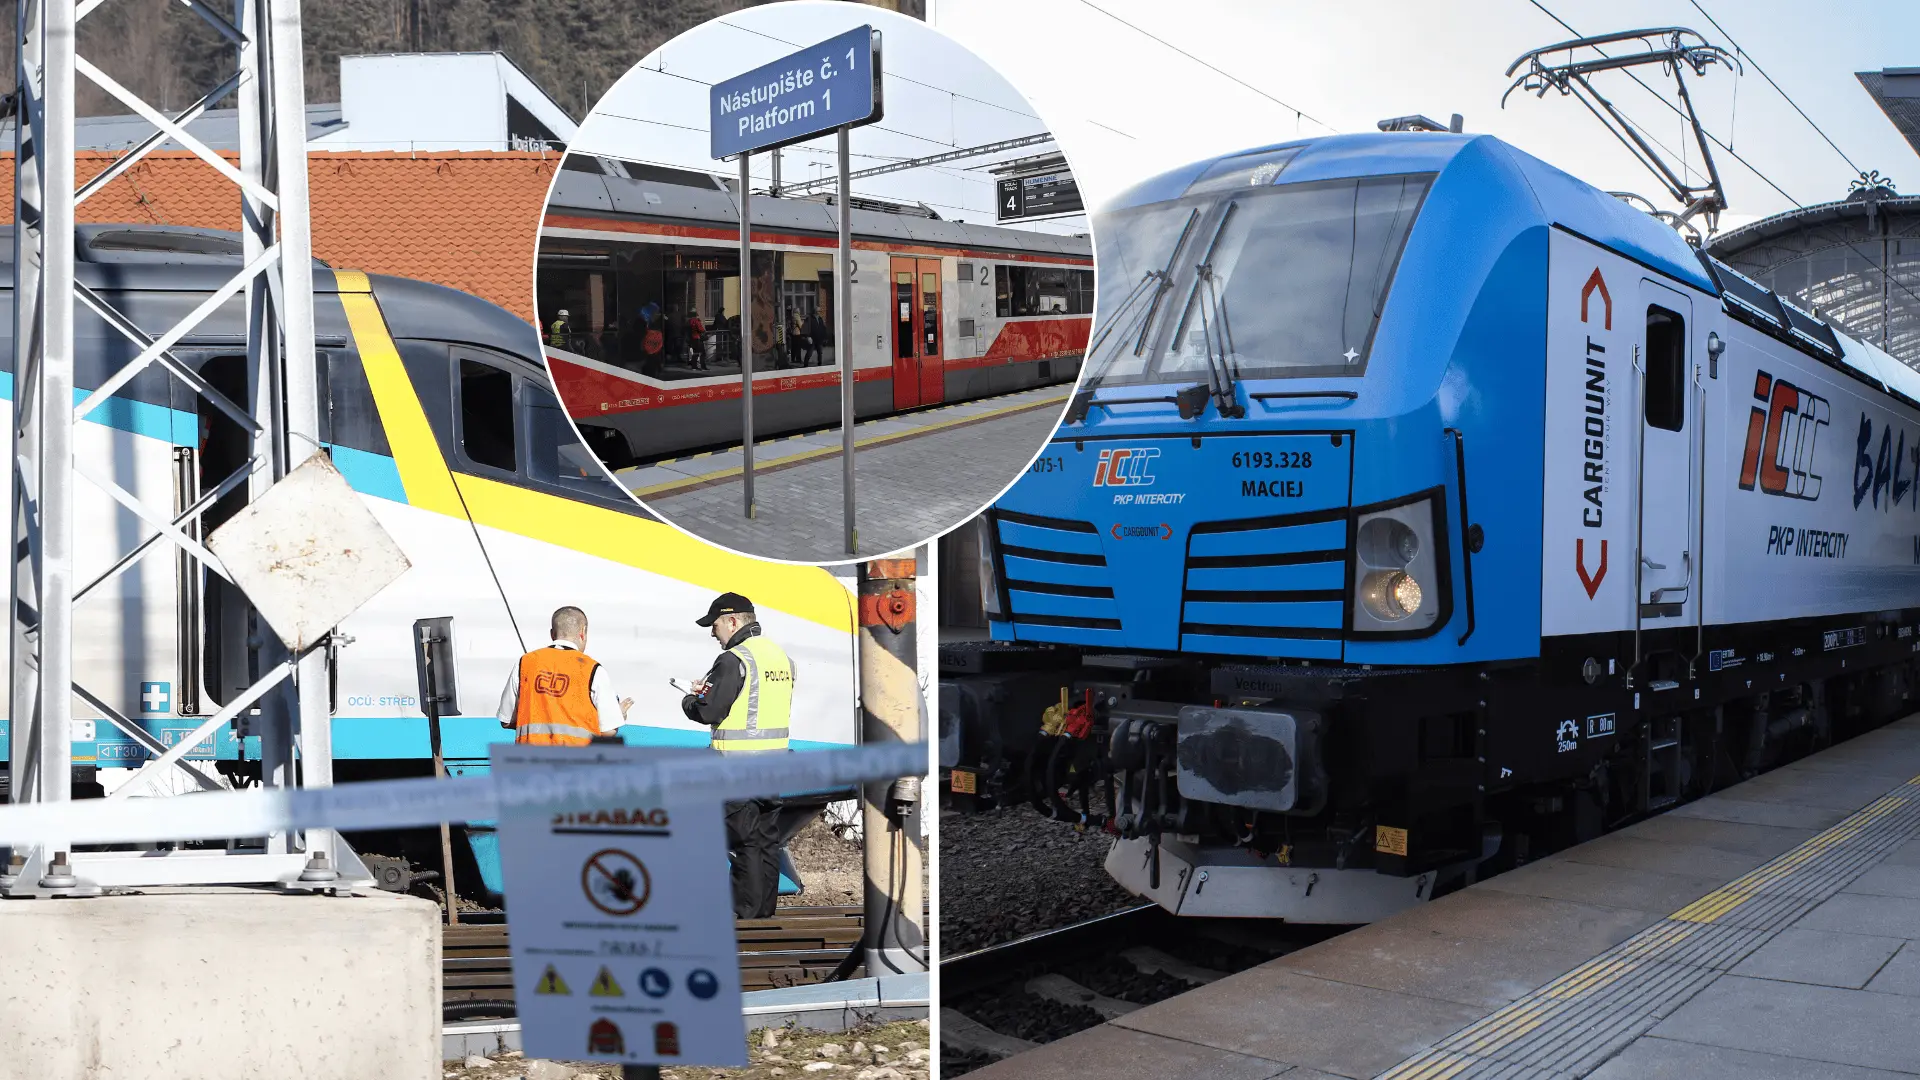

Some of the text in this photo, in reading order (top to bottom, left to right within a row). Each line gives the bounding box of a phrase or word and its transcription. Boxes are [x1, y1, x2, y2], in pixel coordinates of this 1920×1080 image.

[720, 47, 855, 116] Nástupište č. 1
[738, 88, 831, 137] Platform 1
[1006, 195, 1016, 211] 4
[980, 265, 989, 286] 2
[1583, 335, 1606, 528] CARGOUNIT
[1231, 451, 1313, 469] 6193.328
[1241, 480, 1304, 498] MACIEJ
[1113, 493, 1186, 505] PKP INTERCITY
[1123, 526, 1159, 538] CARGOUNIT
[1767, 525, 1850, 559] PKP INTERCITY
[1234, 675, 1283, 693] Vectron
[1589, 717, 1613, 734] R 80m
[163, 731, 173, 745] R
[1557, 740, 1578, 753] 250m
